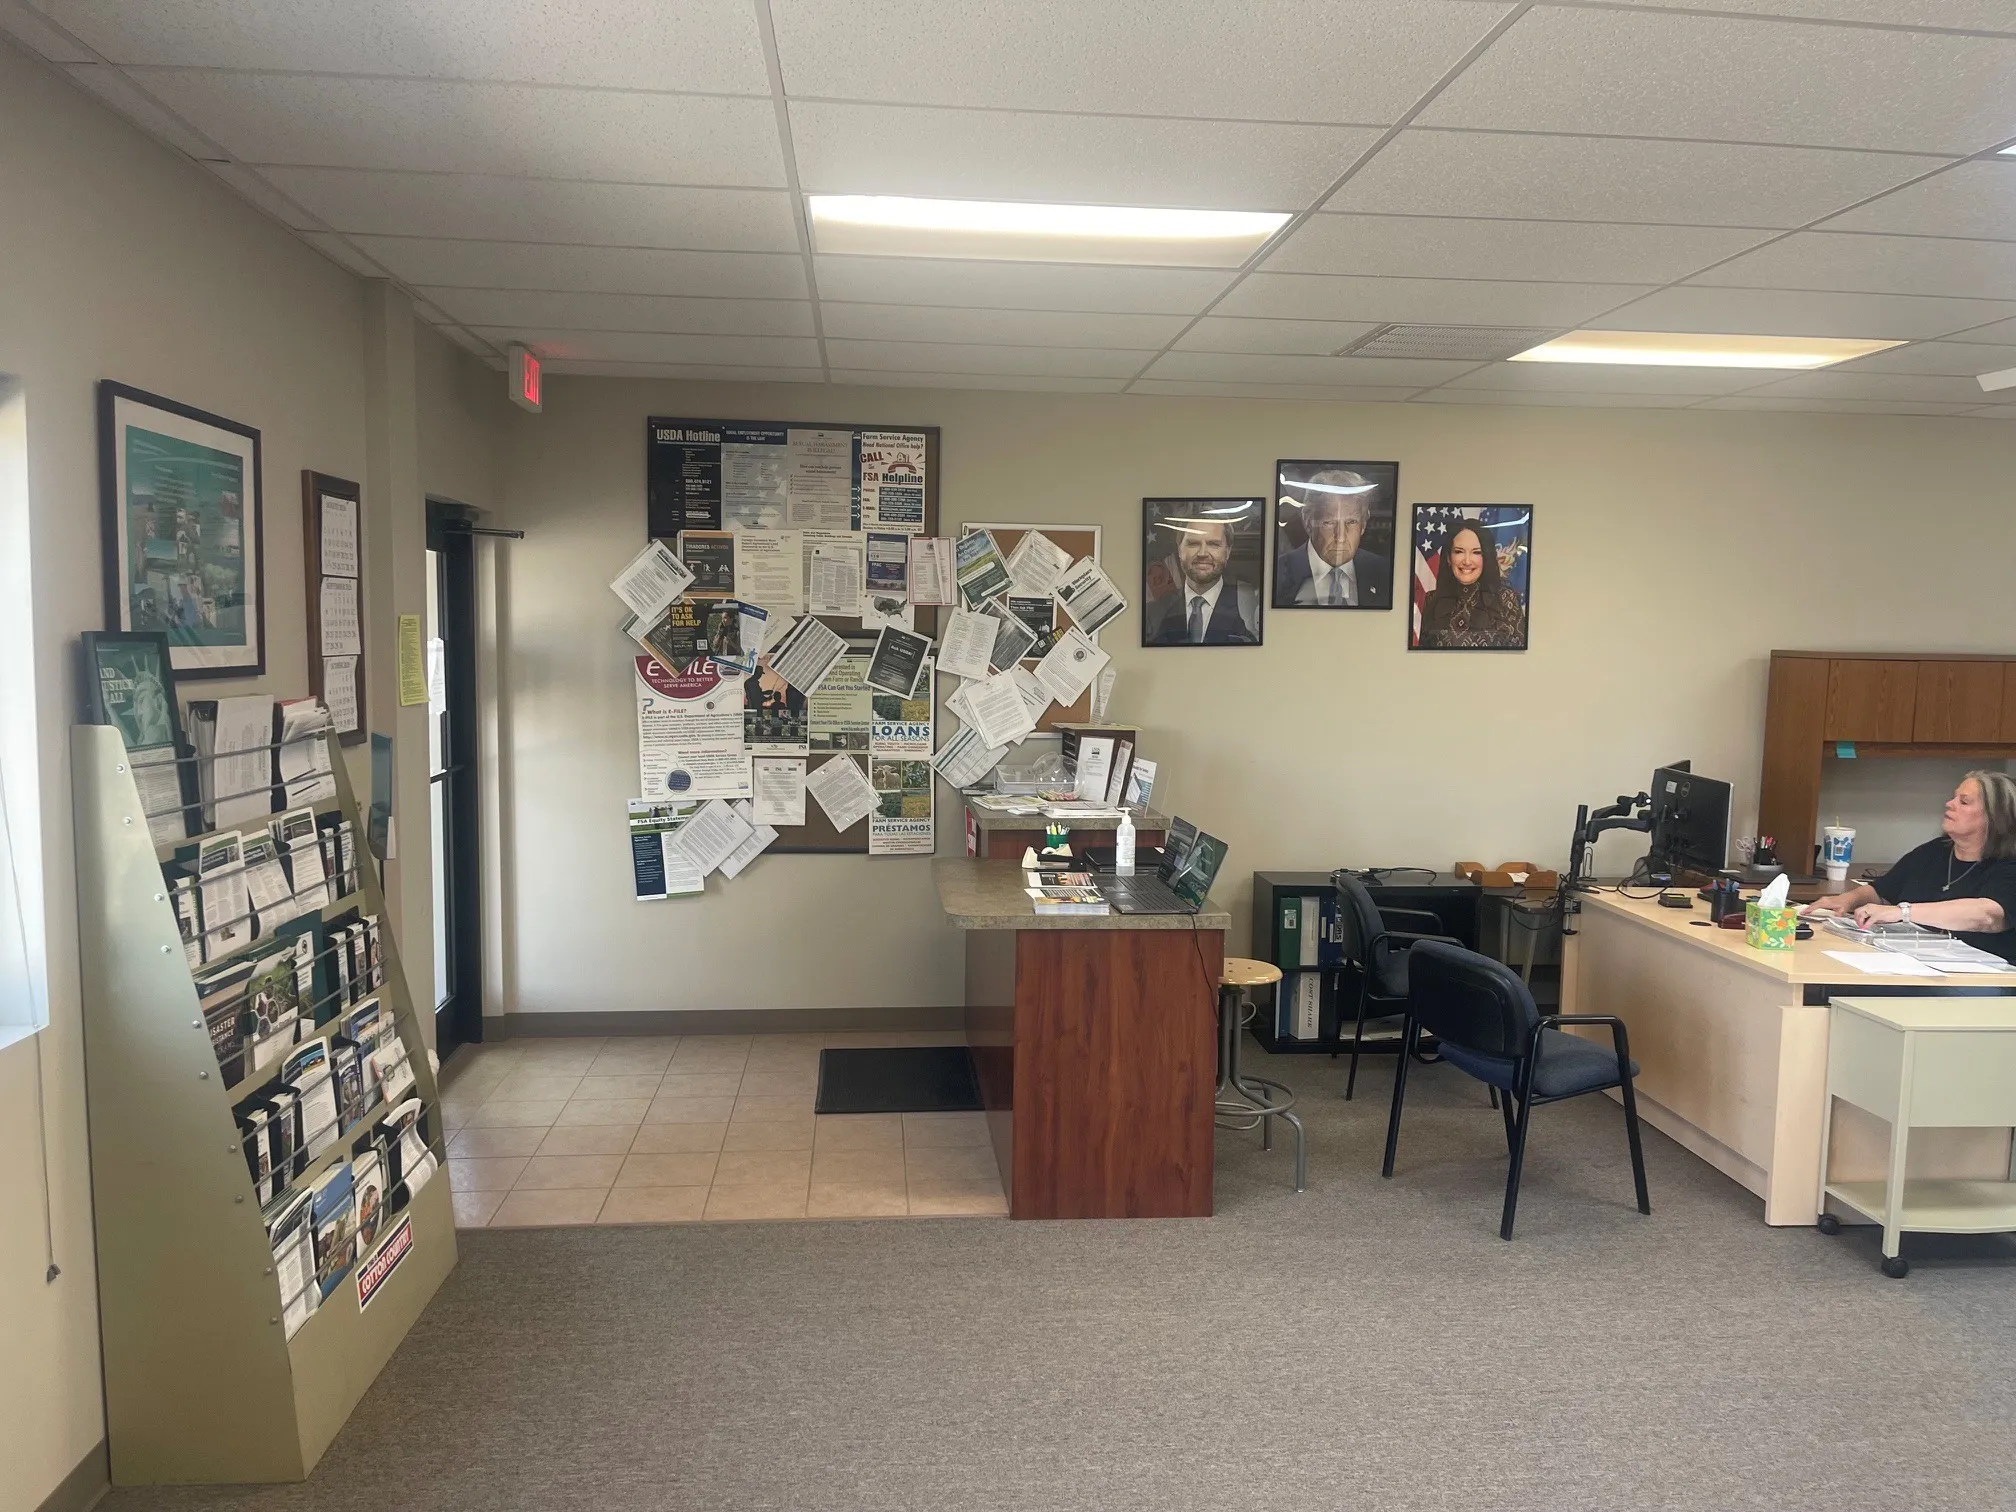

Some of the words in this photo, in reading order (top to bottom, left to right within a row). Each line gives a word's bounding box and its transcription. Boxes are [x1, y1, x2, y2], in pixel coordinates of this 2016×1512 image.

[656, 429, 683, 441] USDA
[686, 430, 720, 442] Hotline
[860, 451, 884, 462] CALL
[863, 472, 878, 481] FSA
[882, 473, 923, 484] Helpline
[1072, 568, 1092, 586] Workplace
[1075, 576, 1092, 590] Security
[872, 726, 930, 736] LOANS
[873, 823, 931, 832] PRÉSTAMOS
[362, 1254, 387, 1294] COTTON
[387, 1229, 409, 1266] COUNTRY
